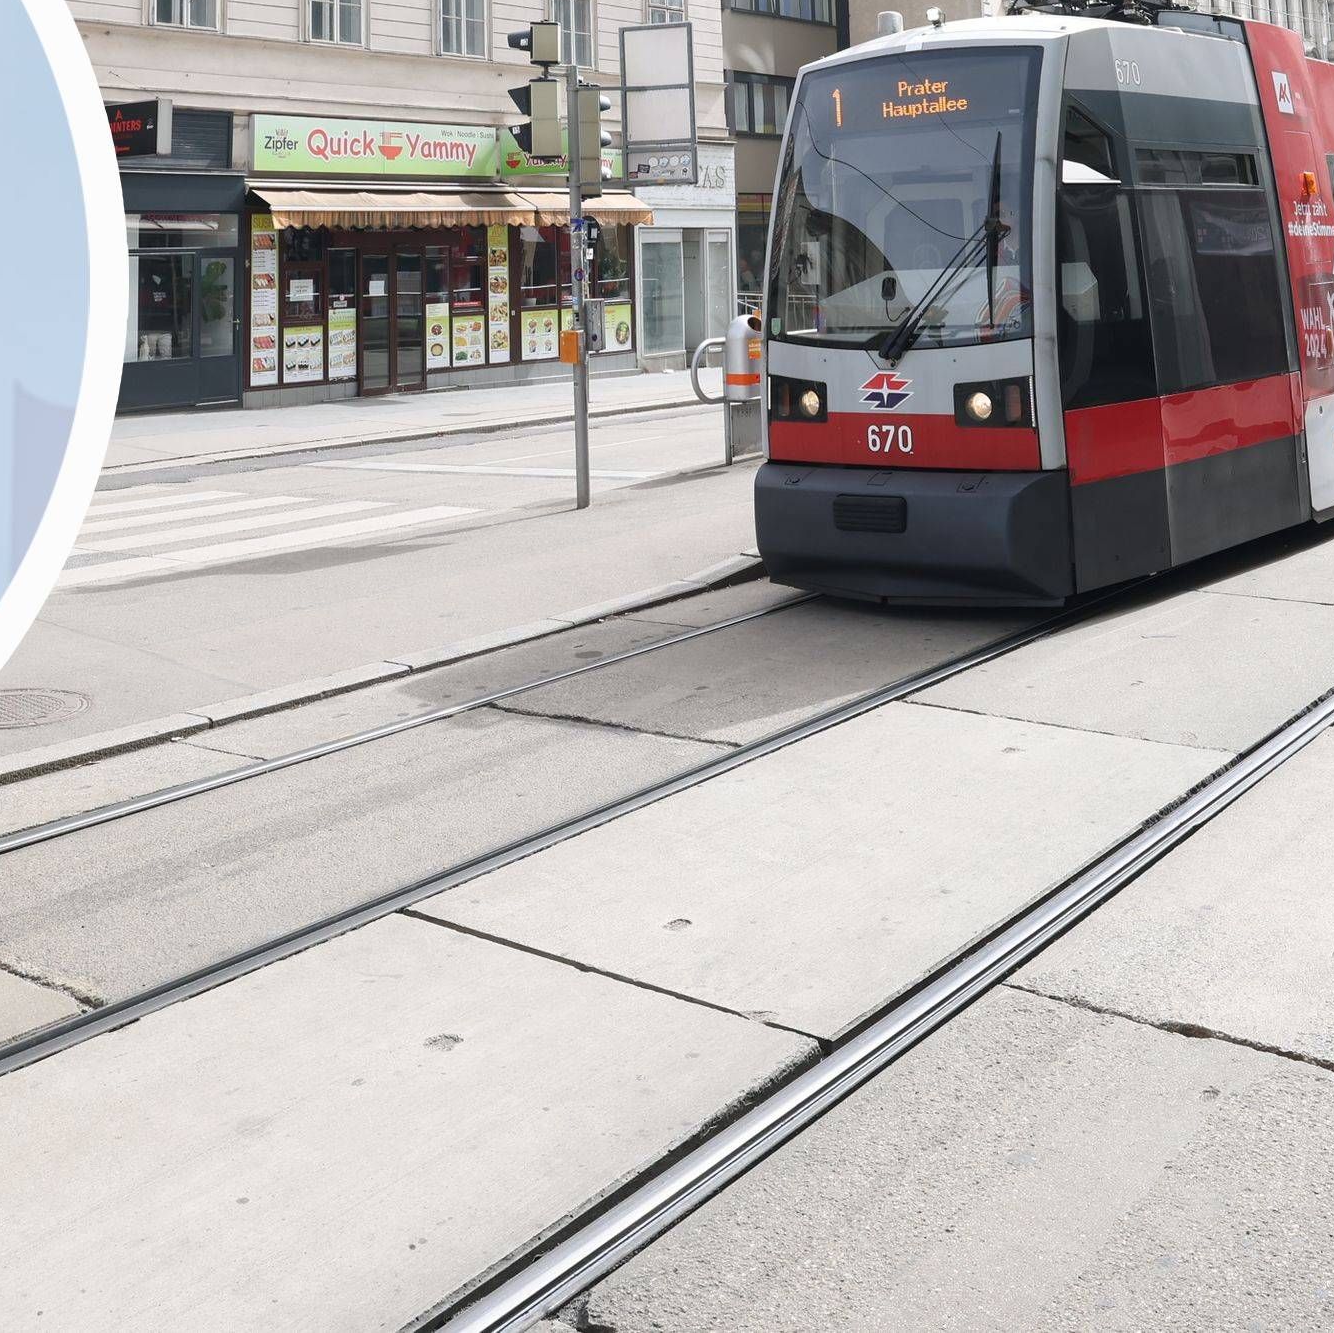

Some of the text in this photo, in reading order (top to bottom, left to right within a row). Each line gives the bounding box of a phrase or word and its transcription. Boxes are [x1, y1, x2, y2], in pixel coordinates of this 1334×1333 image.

[1115, 59, 1141, 86] 670
[898, 79, 949, 97] Prater
[1279, 83, 1291, 104] AK
[832, 88, 843, 128] 1
[882, 96, 968, 118] Hauptallee
[264, 135, 299, 151] Zipfer
[441, 129, 453, 137] Wok
[307, 129, 477, 168] Quick Yammy
[1293, 199, 1328, 216] Jetzt zählt
[1300, 306, 1326, 330] WAHL
[1305, 333, 1328, 359] 2024
[867, 425, 912, 453] 670
